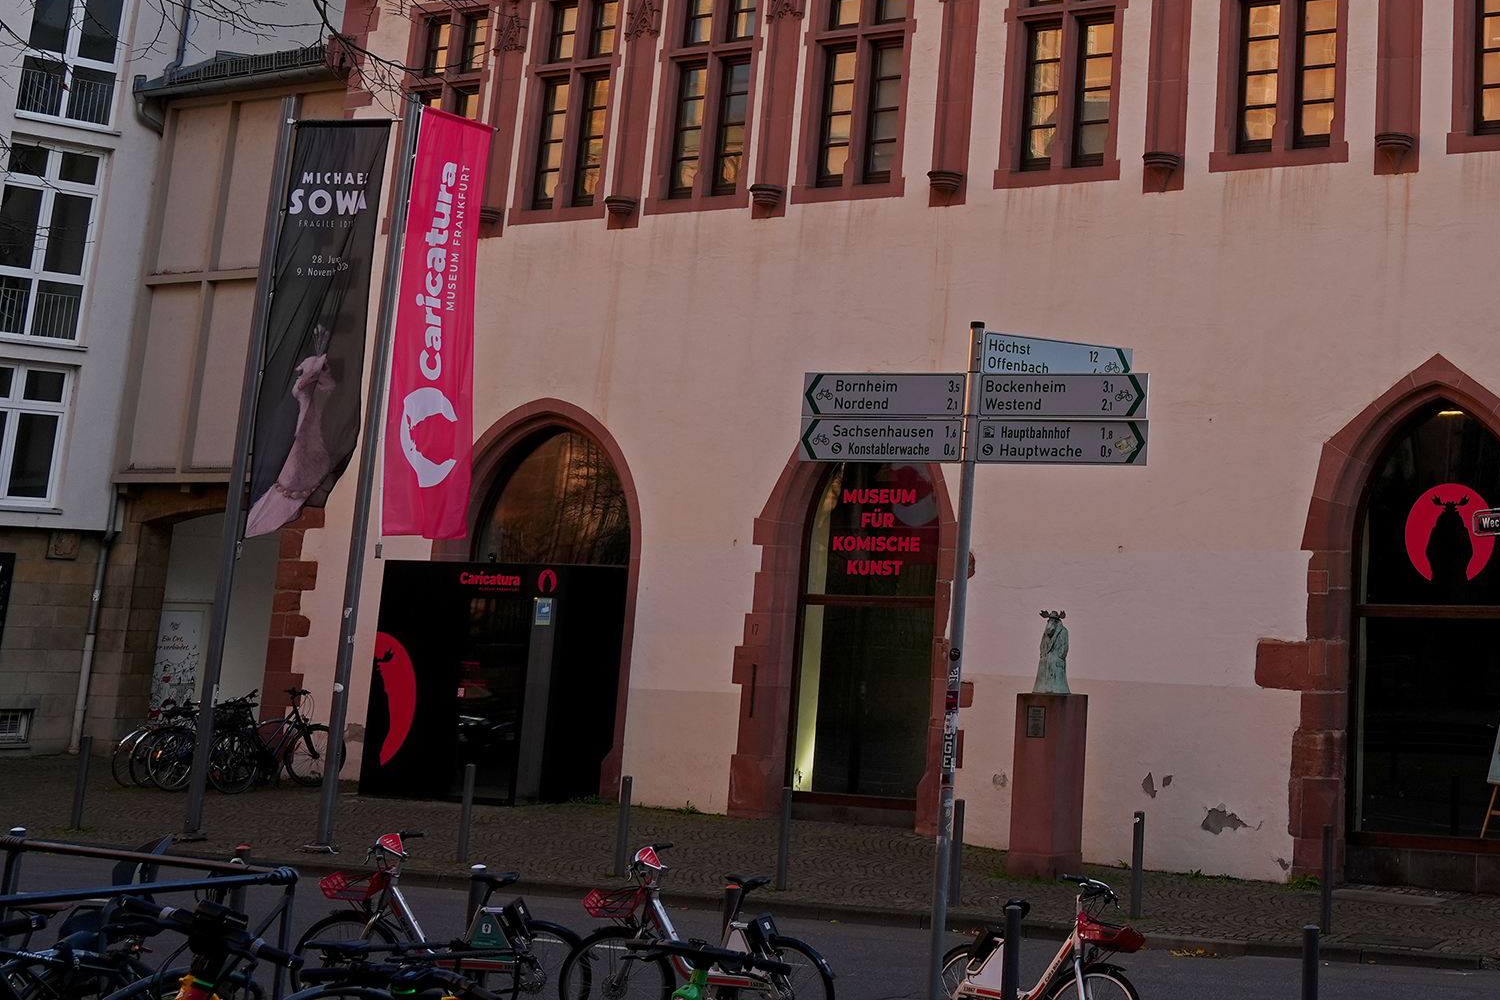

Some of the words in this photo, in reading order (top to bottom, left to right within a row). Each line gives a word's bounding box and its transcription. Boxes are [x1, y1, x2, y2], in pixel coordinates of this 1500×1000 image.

[452, 165, 471, 247] FRANKFURT
[298, 219, 335, 228] FRAGILE
[311, 254, 325, 264] 28.
[296, 267, 304, 277] 9.
[415, 160, 458, 381] Caricatura
[445, 252, 460, 311] MUSEUM
[989, 338, 1031, 356] Höchst
[1089, 350, 1099, 363] 12
[987, 356, 1049, 374] Offenbach
[835, 380, 898, 392] Bornheim
[985, 380, 1066, 393] Bockenheim
[834, 397, 889, 410] Nordend
[985, 398, 1041, 410] Westend
[832, 425, 934, 437] Sachsenhausen
[1001, 425, 1070, 441] Hauptbahnhof
[848, 442, 930, 455] Konstablerwache
[1000, 443, 1082, 459] Hauptwache
[843, 488, 916, 504] MUSEUM
[861, 508, 895, 528] FÜR
[832, 535, 921, 552] KOMISCHE
[846, 560, 904, 576] KUNST
[459, 570, 521, 587] Caricatura
